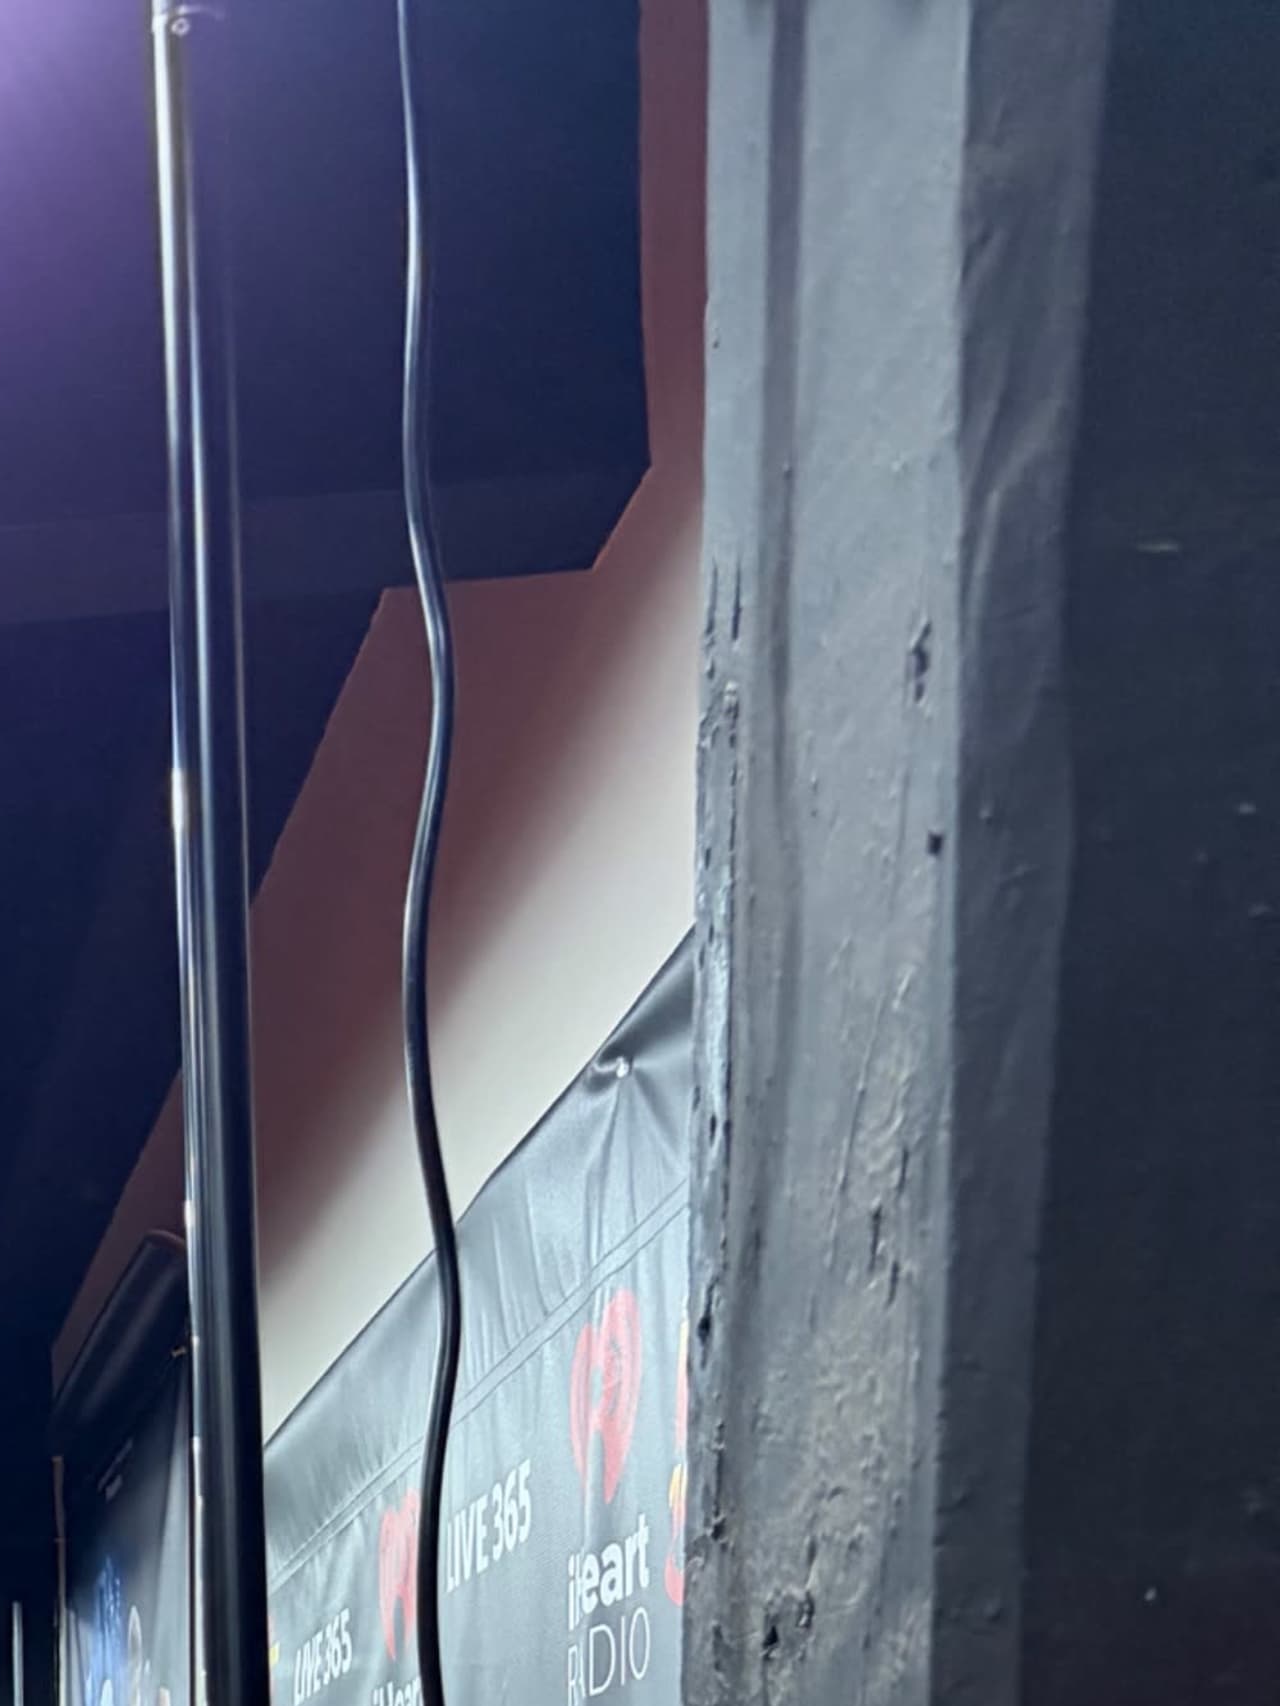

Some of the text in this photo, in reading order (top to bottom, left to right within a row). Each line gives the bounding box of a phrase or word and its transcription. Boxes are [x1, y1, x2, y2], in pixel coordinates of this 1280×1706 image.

[446, 1458, 532, 1593] LIVE 365
[321, 1607, 353, 1685] 365
